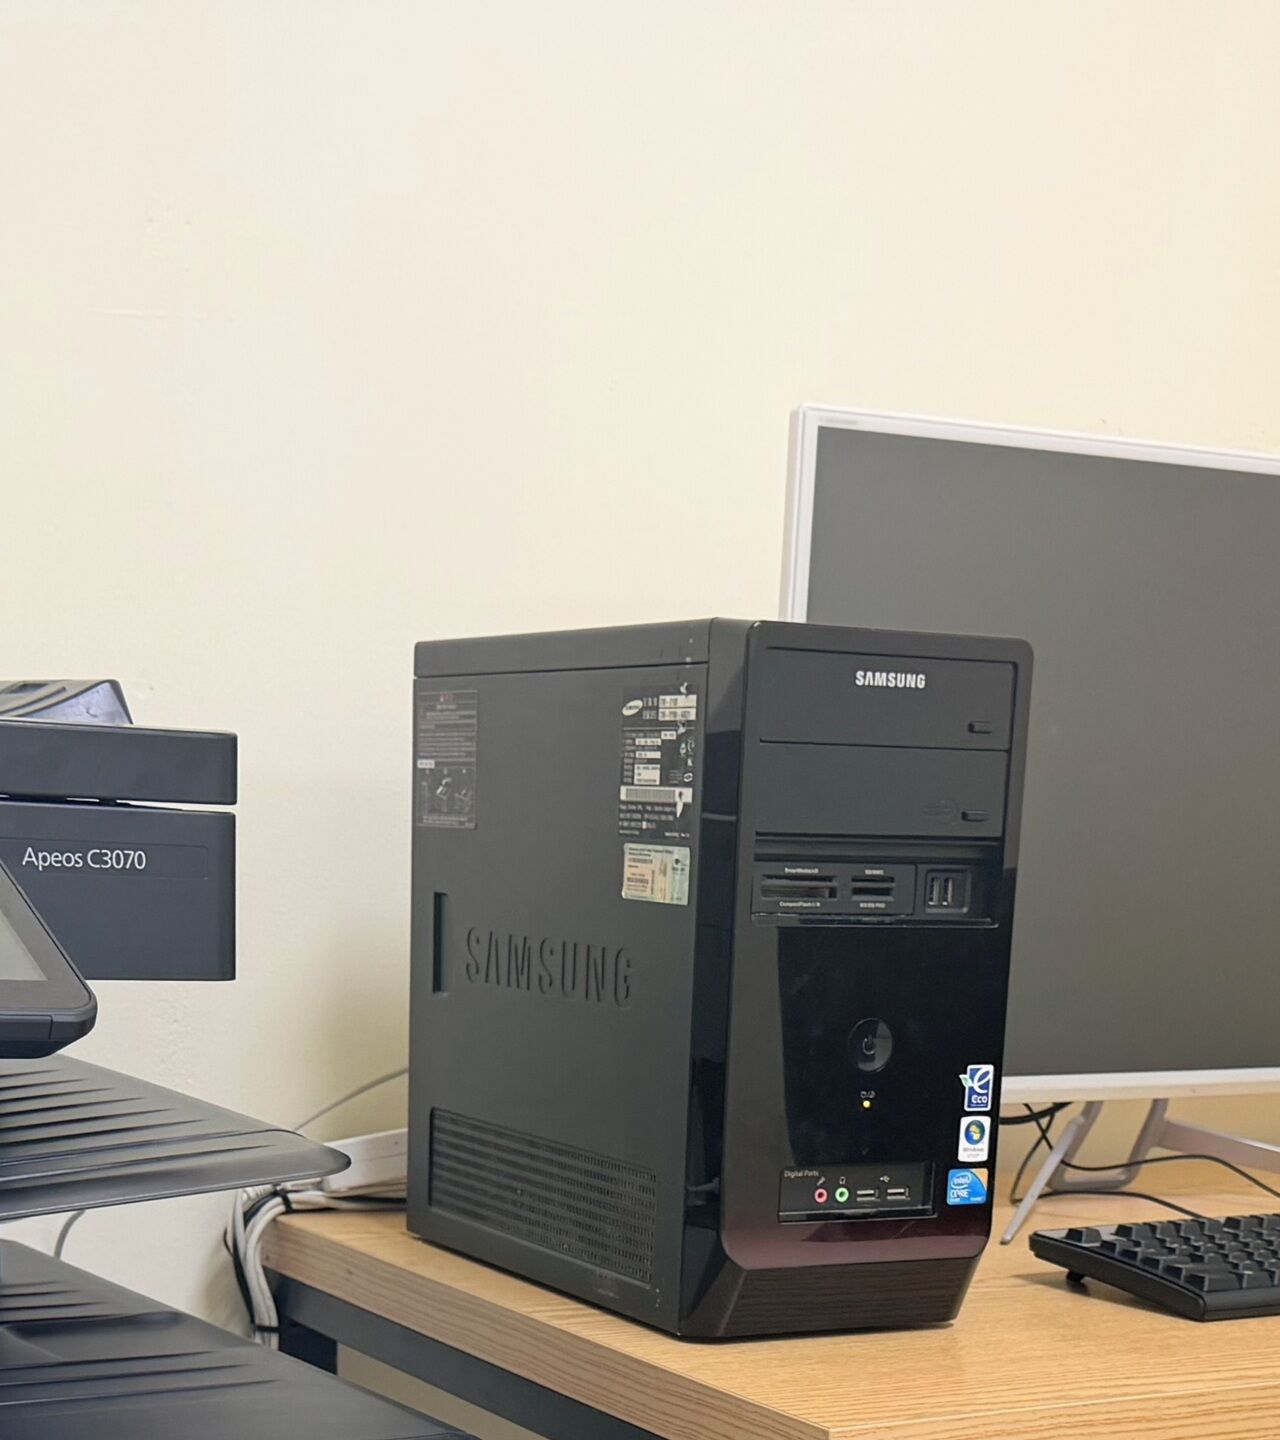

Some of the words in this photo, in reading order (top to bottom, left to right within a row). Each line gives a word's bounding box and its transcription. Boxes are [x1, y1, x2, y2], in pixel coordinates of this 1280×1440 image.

[855, 670, 926, 689] SAMSUNG
[22, 846, 84, 871] Apeos
[86, 848, 147, 870] C3070
[466, 927, 632, 1009] SAMSUNG
[784, 1170, 803, 1179] Digital
